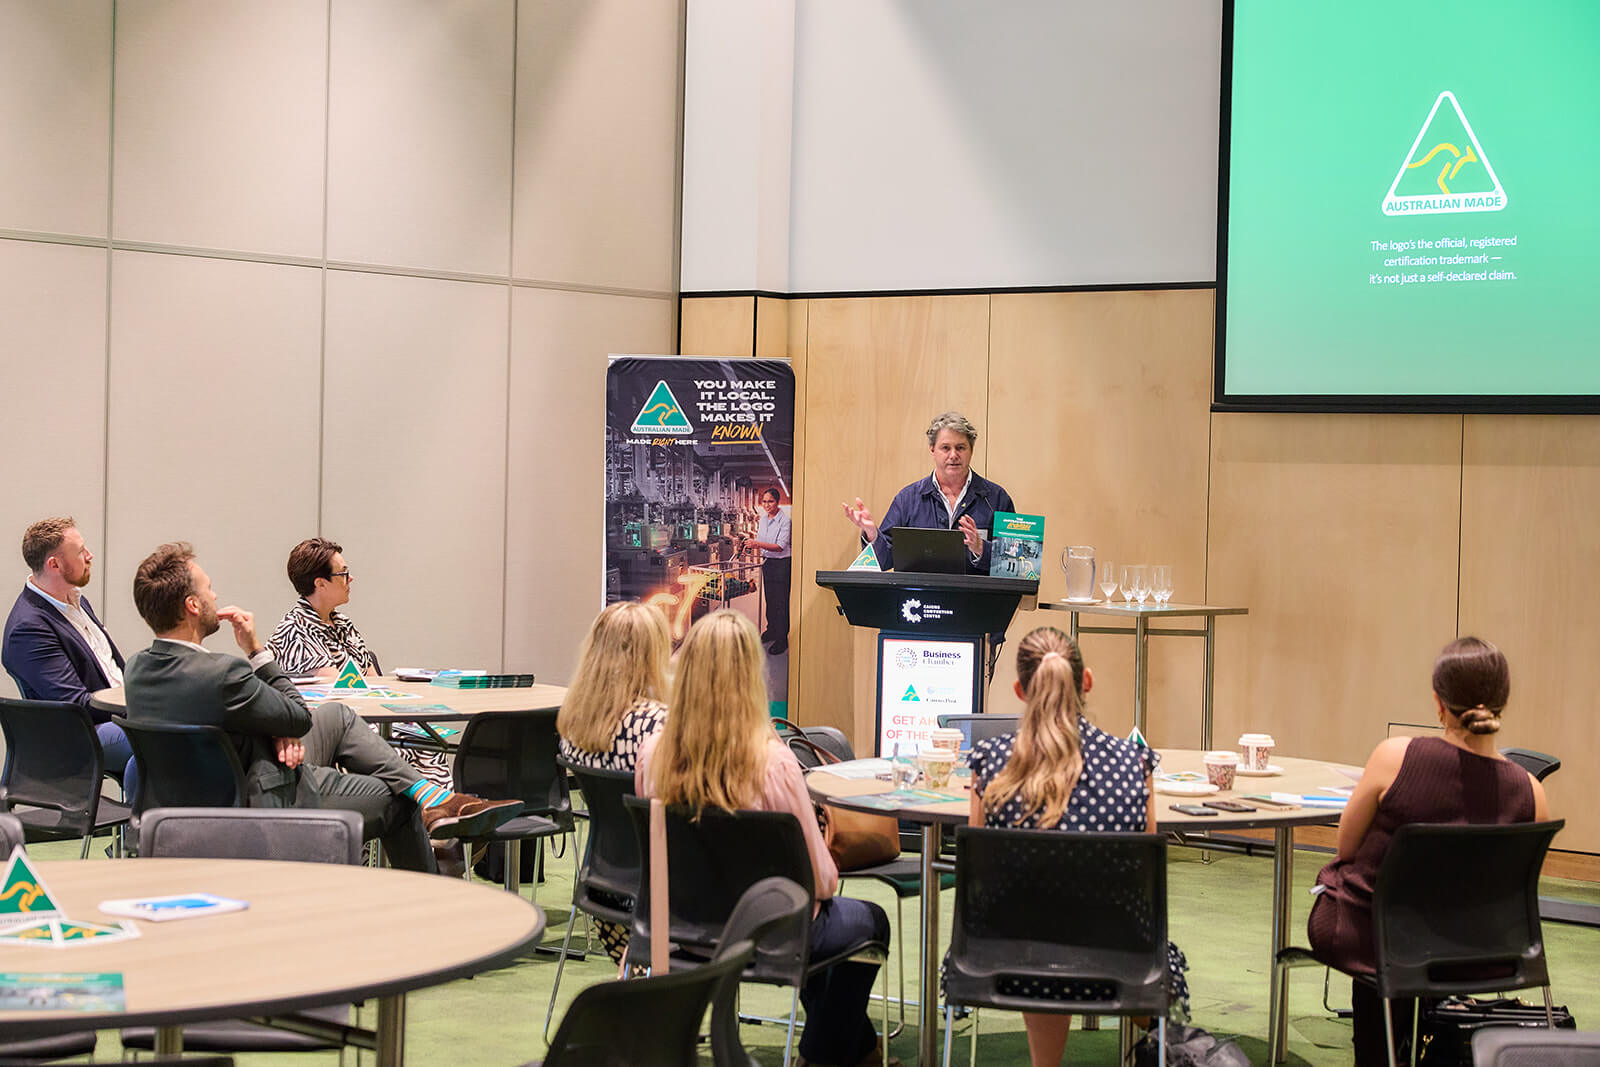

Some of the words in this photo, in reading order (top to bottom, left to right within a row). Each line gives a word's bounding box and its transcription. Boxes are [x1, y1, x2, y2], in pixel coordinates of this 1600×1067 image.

[1385, 198, 1461, 212] AUSTRALIAN
[1464, 196, 1502, 209] MADE
[1370, 240, 1388, 251] The
[1389, 239, 1416, 253] logo's
[1417, 239, 1434, 249] the
[1434, 237, 1468, 249] official,
[1469, 235, 1518, 249] registered
[1383, 255, 1438, 267] certification
[1439, 252, 1489, 265] trademark
[1369, 273, 1383, 284] it's
[1383, 274, 1401, 284] not
[1400, 272, 1418, 286] just
[1419, 274, 1426, 282] a
[1427, 270, 1488, 282] self-declared
[1488, 269, 1518, 281] claim.
[693, 380, 727, 389] YOU
[730, 380, 776, 389] MAKE
[700, 391, 716, 400] IT
[718, 391, 775, 400] LOCAL.
[696, 402, 727, 411] THE
[730, 402, 776, 411] LOGO
[700, 413, 756, 422] MAKES
[759, 413, 775, 422] IT
[711, 422, 764, 440] KNOWN
[651, 438, 677, 446] RIGHT
[923, 650, 962, 659] Business
[892, 715, 916, 726] GET
[886, 729, 903, 740] OF
[906, 730, 929, 740] THE
